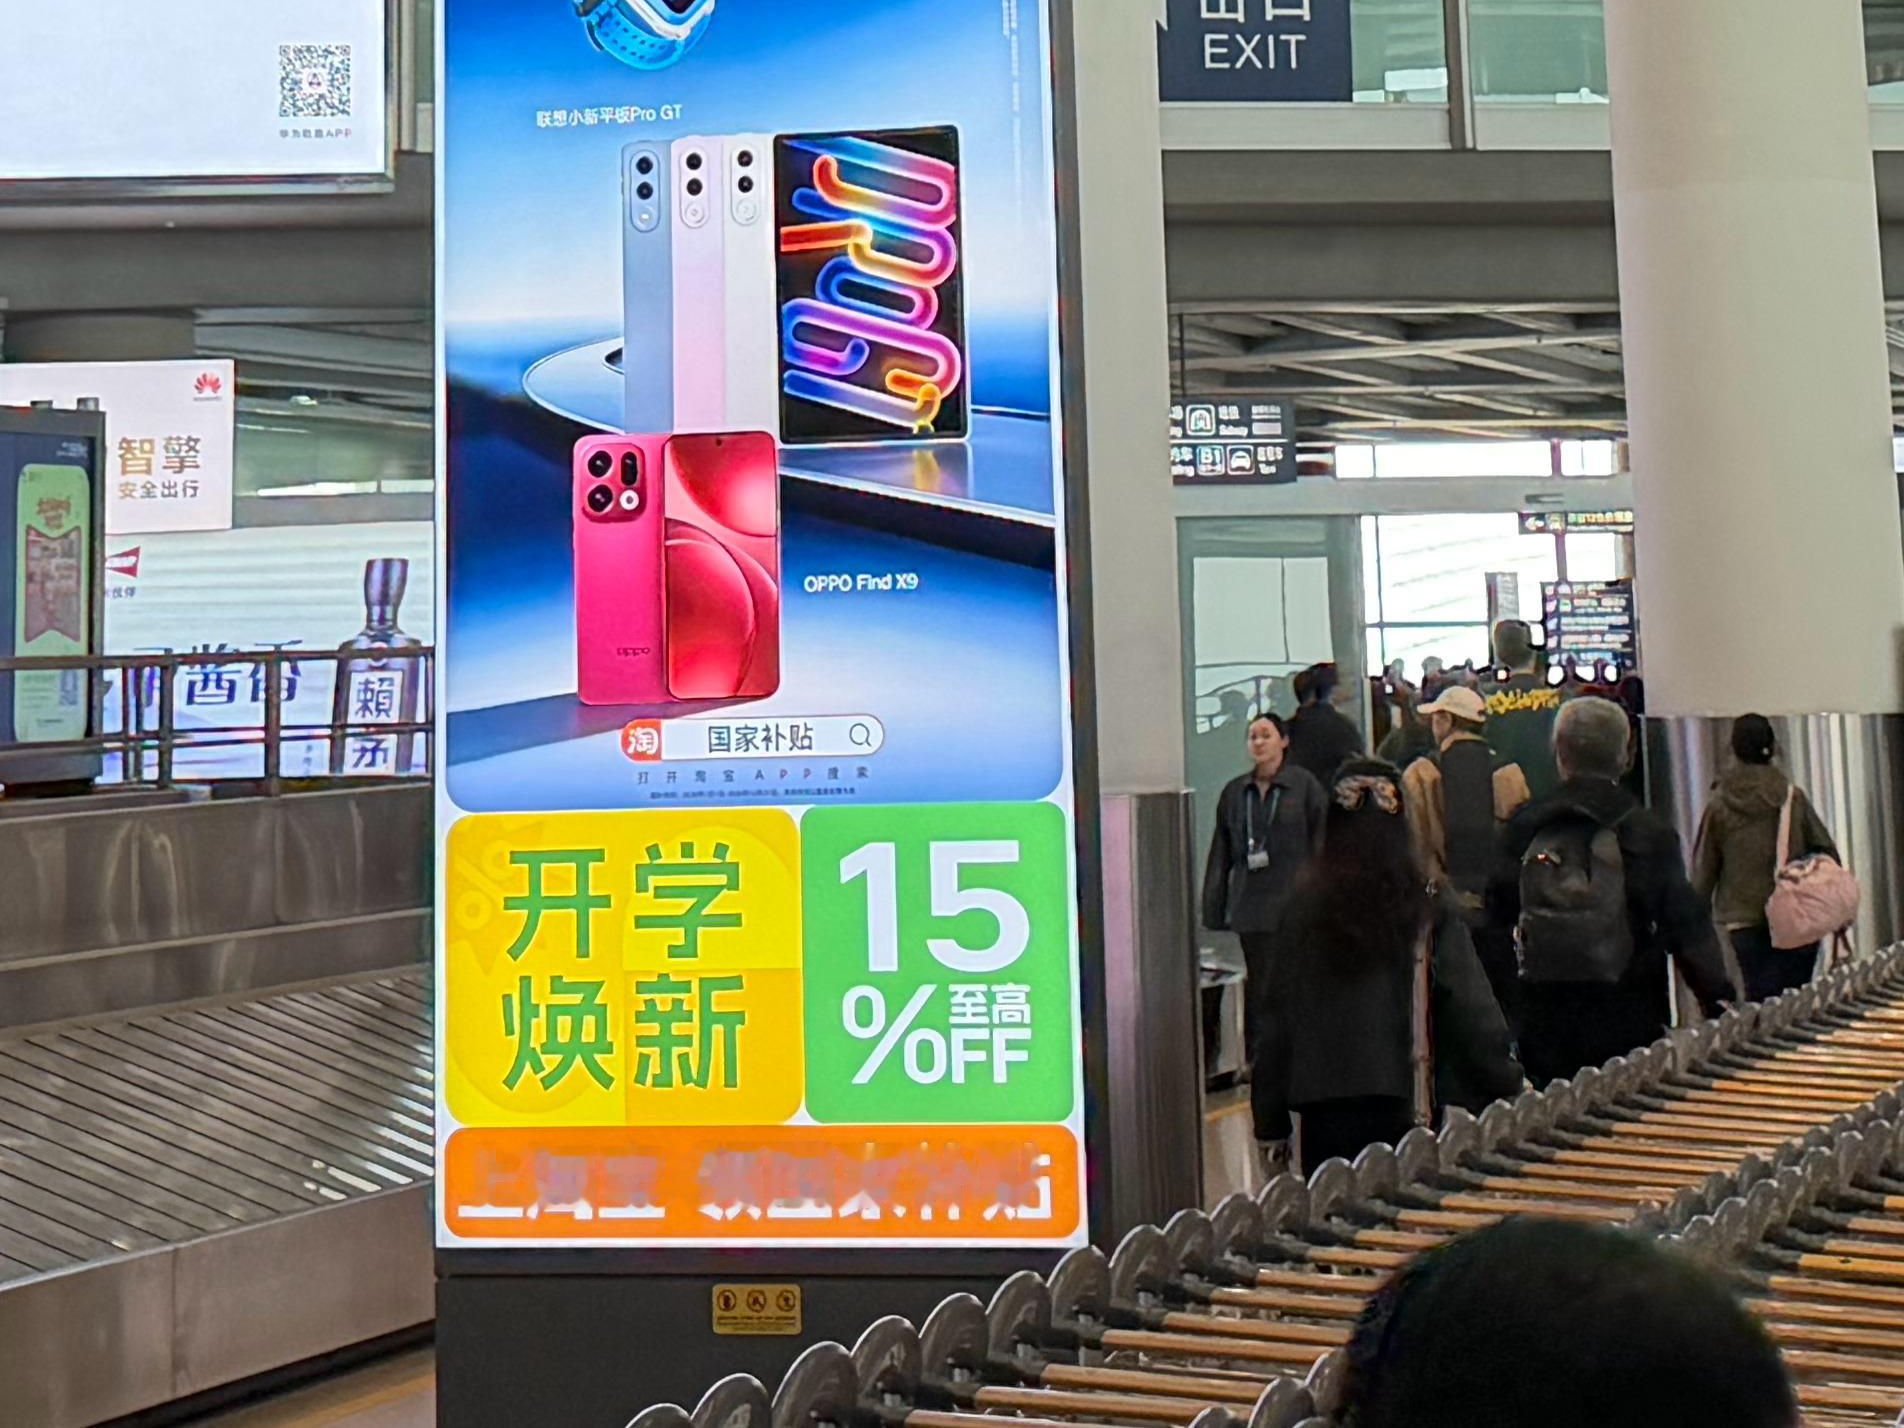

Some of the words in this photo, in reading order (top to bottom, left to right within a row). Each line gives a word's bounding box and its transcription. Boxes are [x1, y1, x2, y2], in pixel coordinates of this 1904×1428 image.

[1203, 33, 1308, 70] EXIT
[659, 103, 683, 121] GT
[117, 435, 202, 476] 智擎
[117, 479, 200, 500] 安全出行
[803, 574, 853, 593] OPPO
[855, 573, 893, 591] Find
[895, 572, 919, 591] X9
[627, 728, 659, 755] 淘
[708, 722, 814, 754] 国家补贴
[502, 841, 744, 962] 开学
[839, 839, 1031, 974] 15
[948, 982, 1031, 1025] 至高
[501, 972, 746, 1092] 焕新
